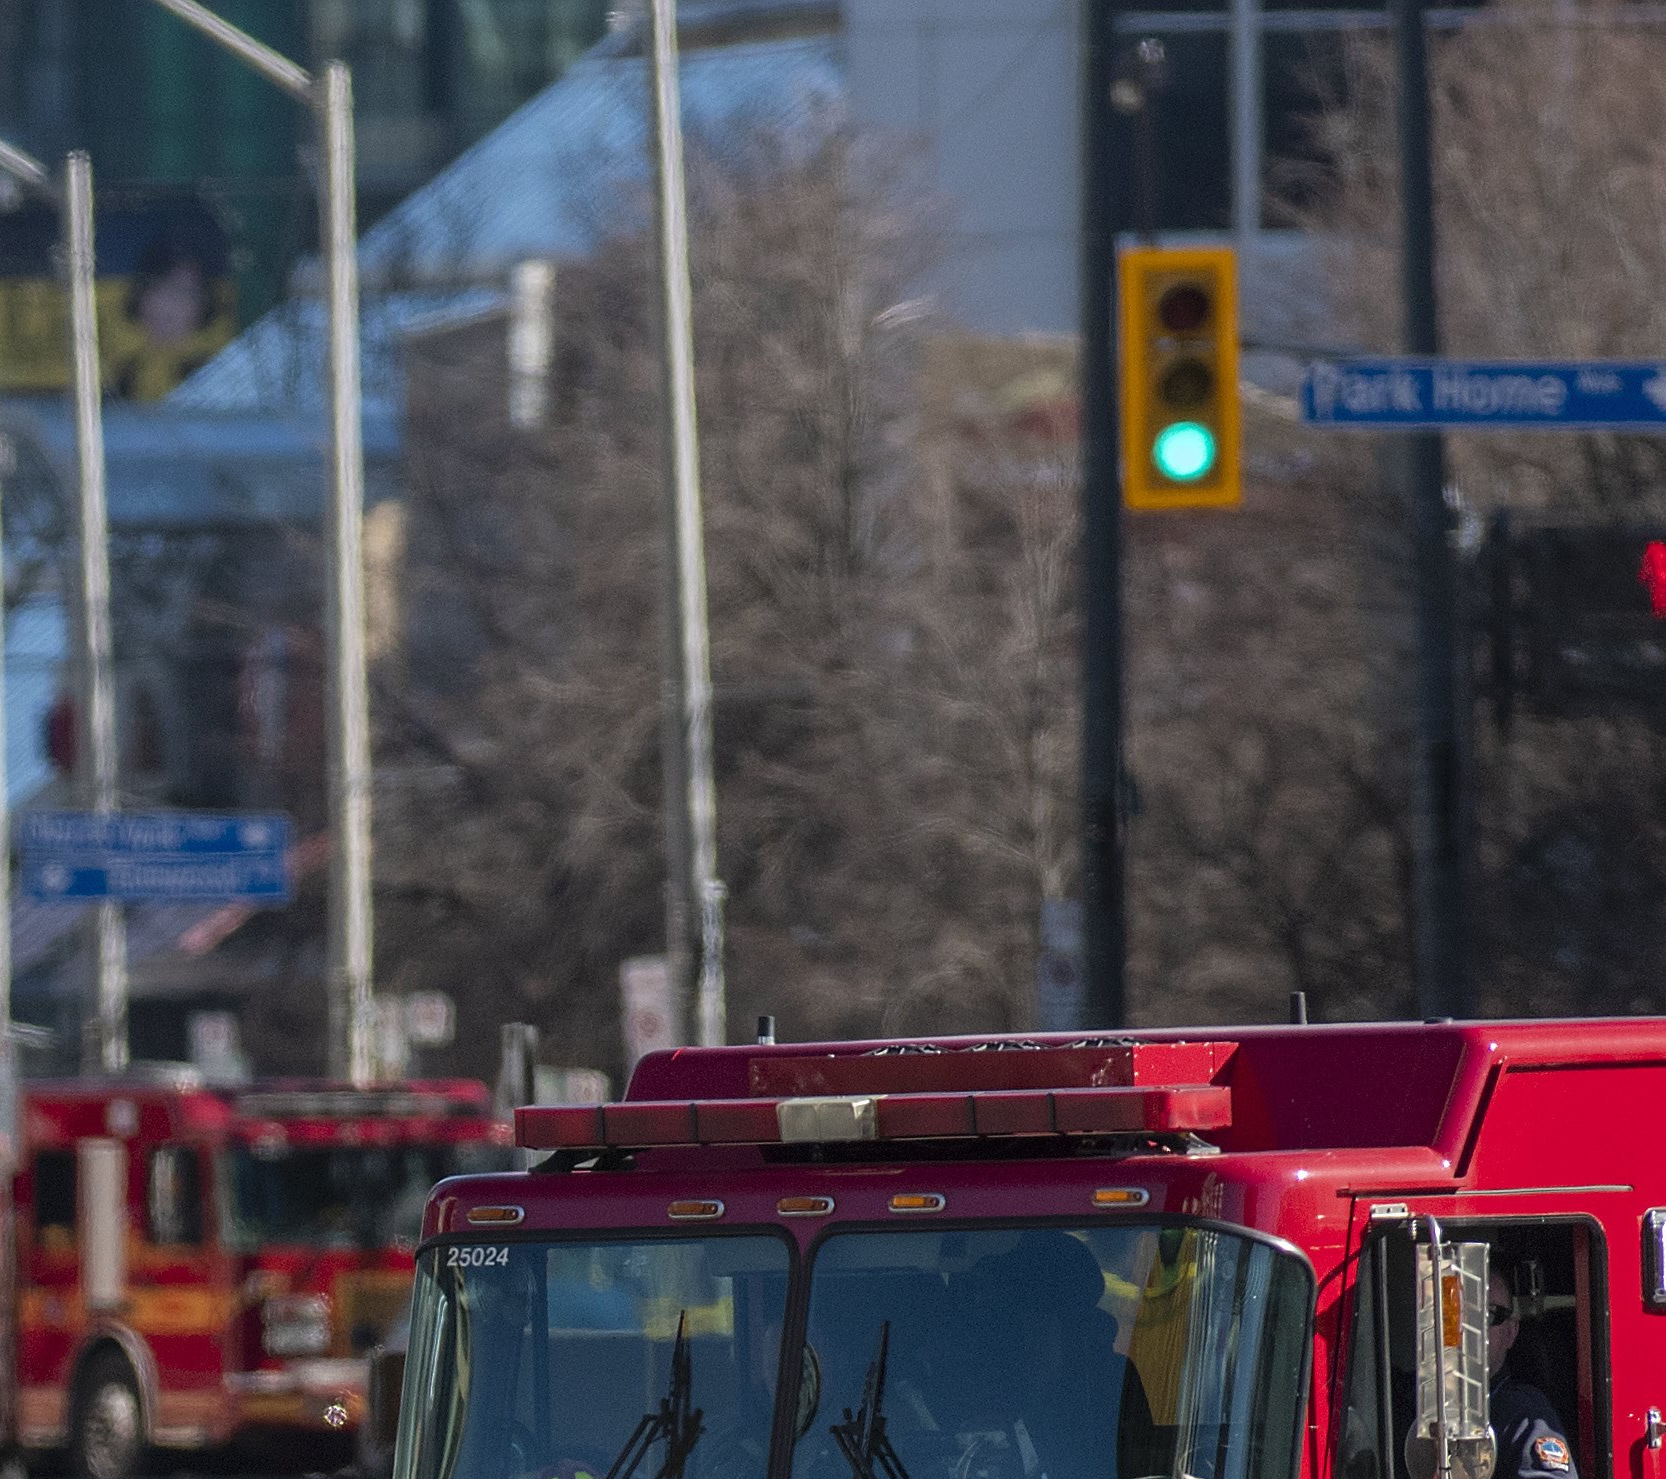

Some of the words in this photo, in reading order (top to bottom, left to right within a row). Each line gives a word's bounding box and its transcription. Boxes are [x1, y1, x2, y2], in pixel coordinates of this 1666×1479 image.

[1314, 366, 1422, 416] Park
[1431, 368, 1567, 415] Home
[447, 1247, 509, 1267] 25024
